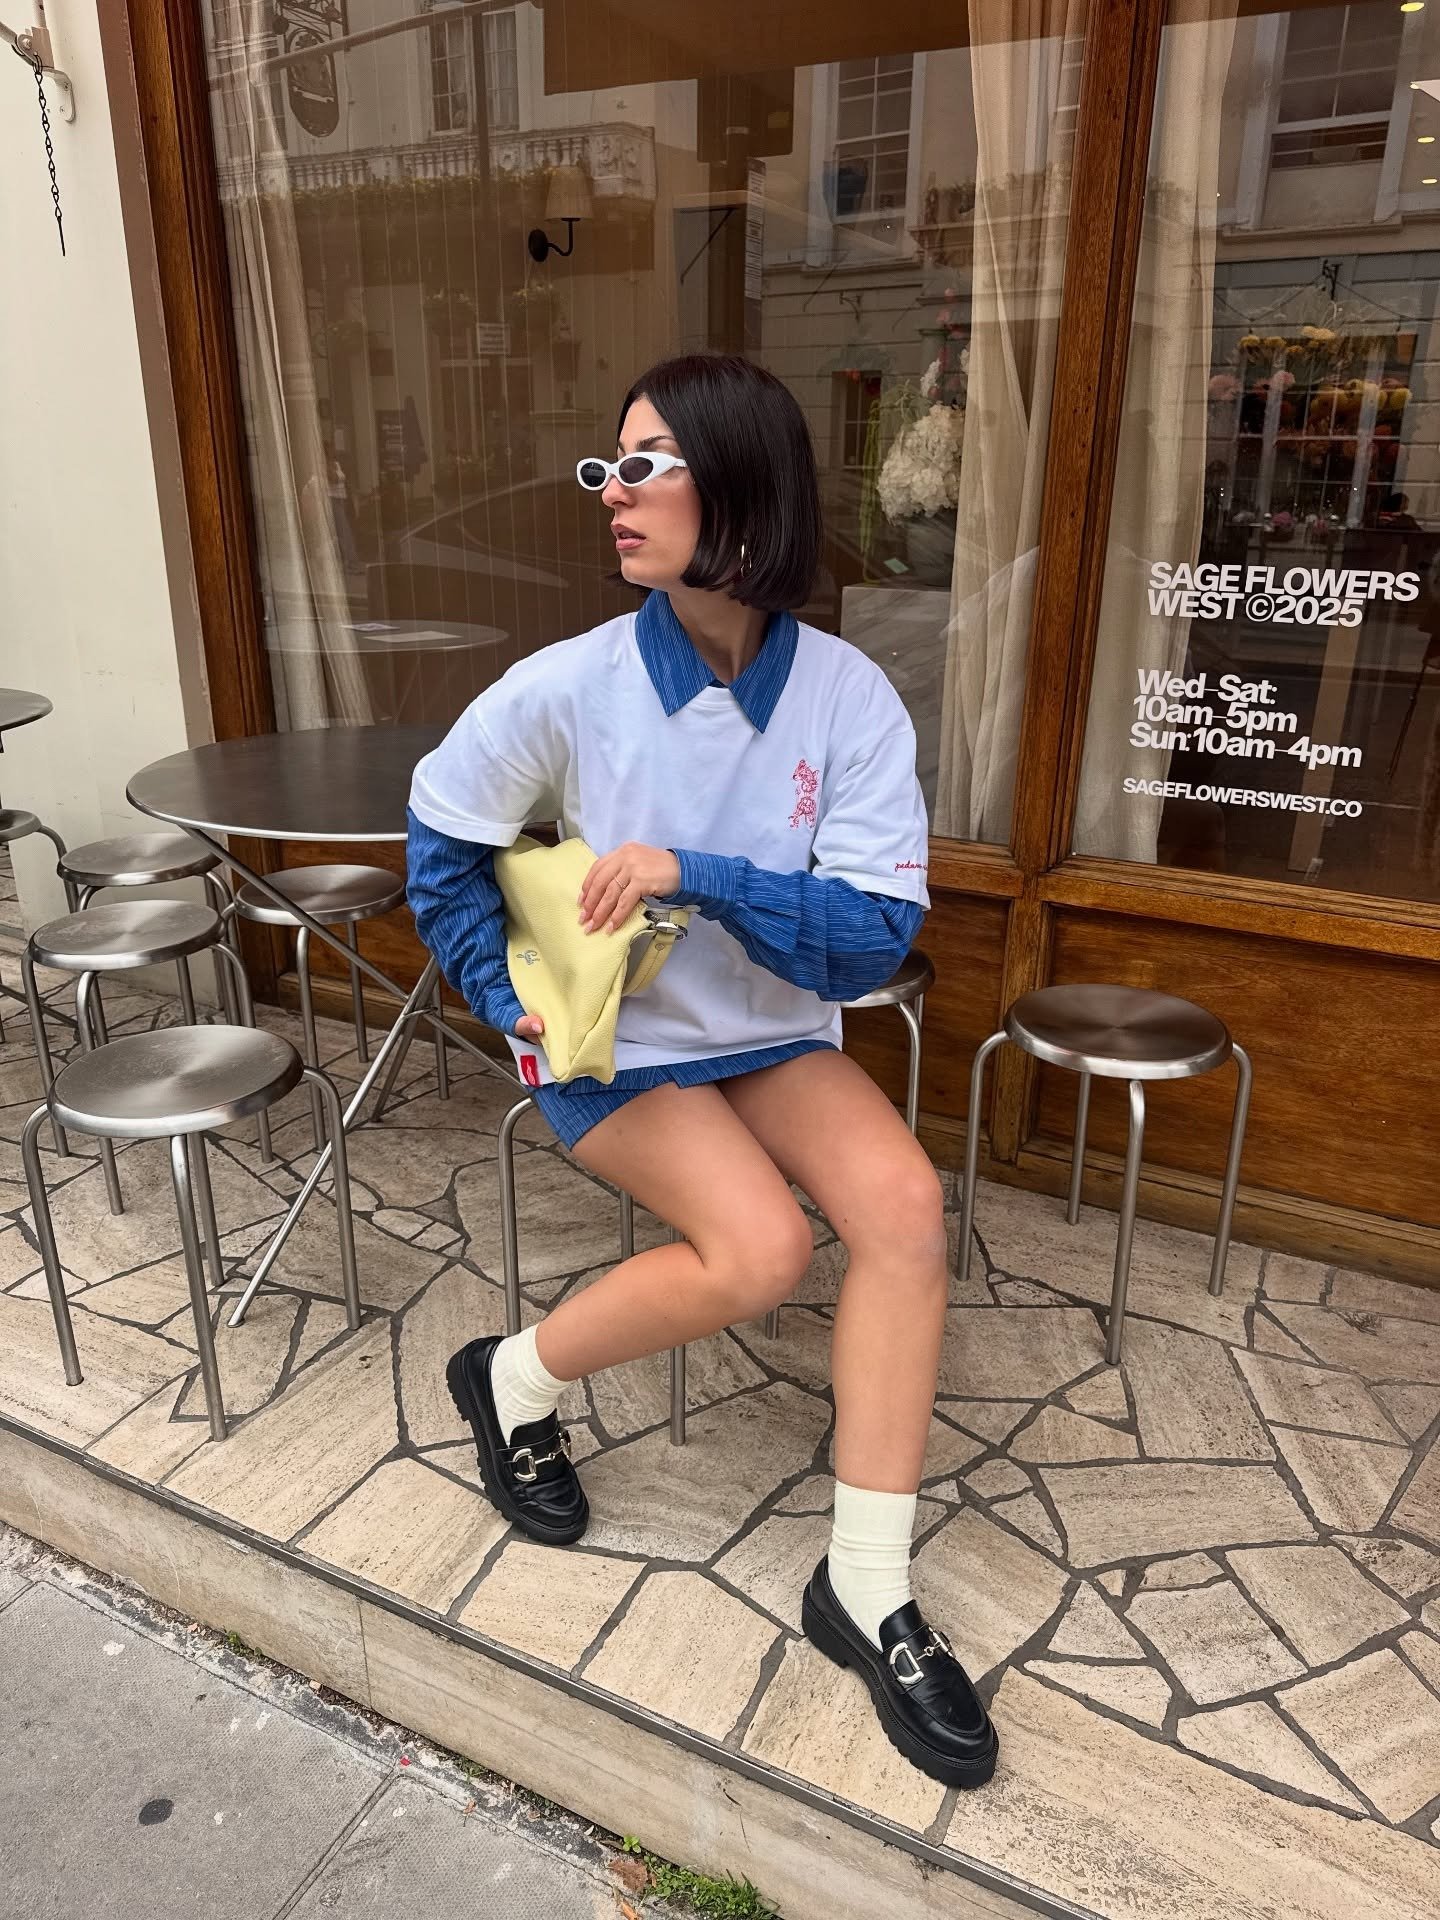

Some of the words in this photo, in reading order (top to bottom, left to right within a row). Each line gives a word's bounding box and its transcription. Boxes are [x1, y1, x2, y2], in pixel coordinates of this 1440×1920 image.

[1149, 562, 1242, 592] SAGE
[1244, 565, 1421, 601] FLOWERS
[1148, 589, 1245, 620] WEST
[1123, 777, 1363, 817] SAGEFLOWERSWEST.CO
